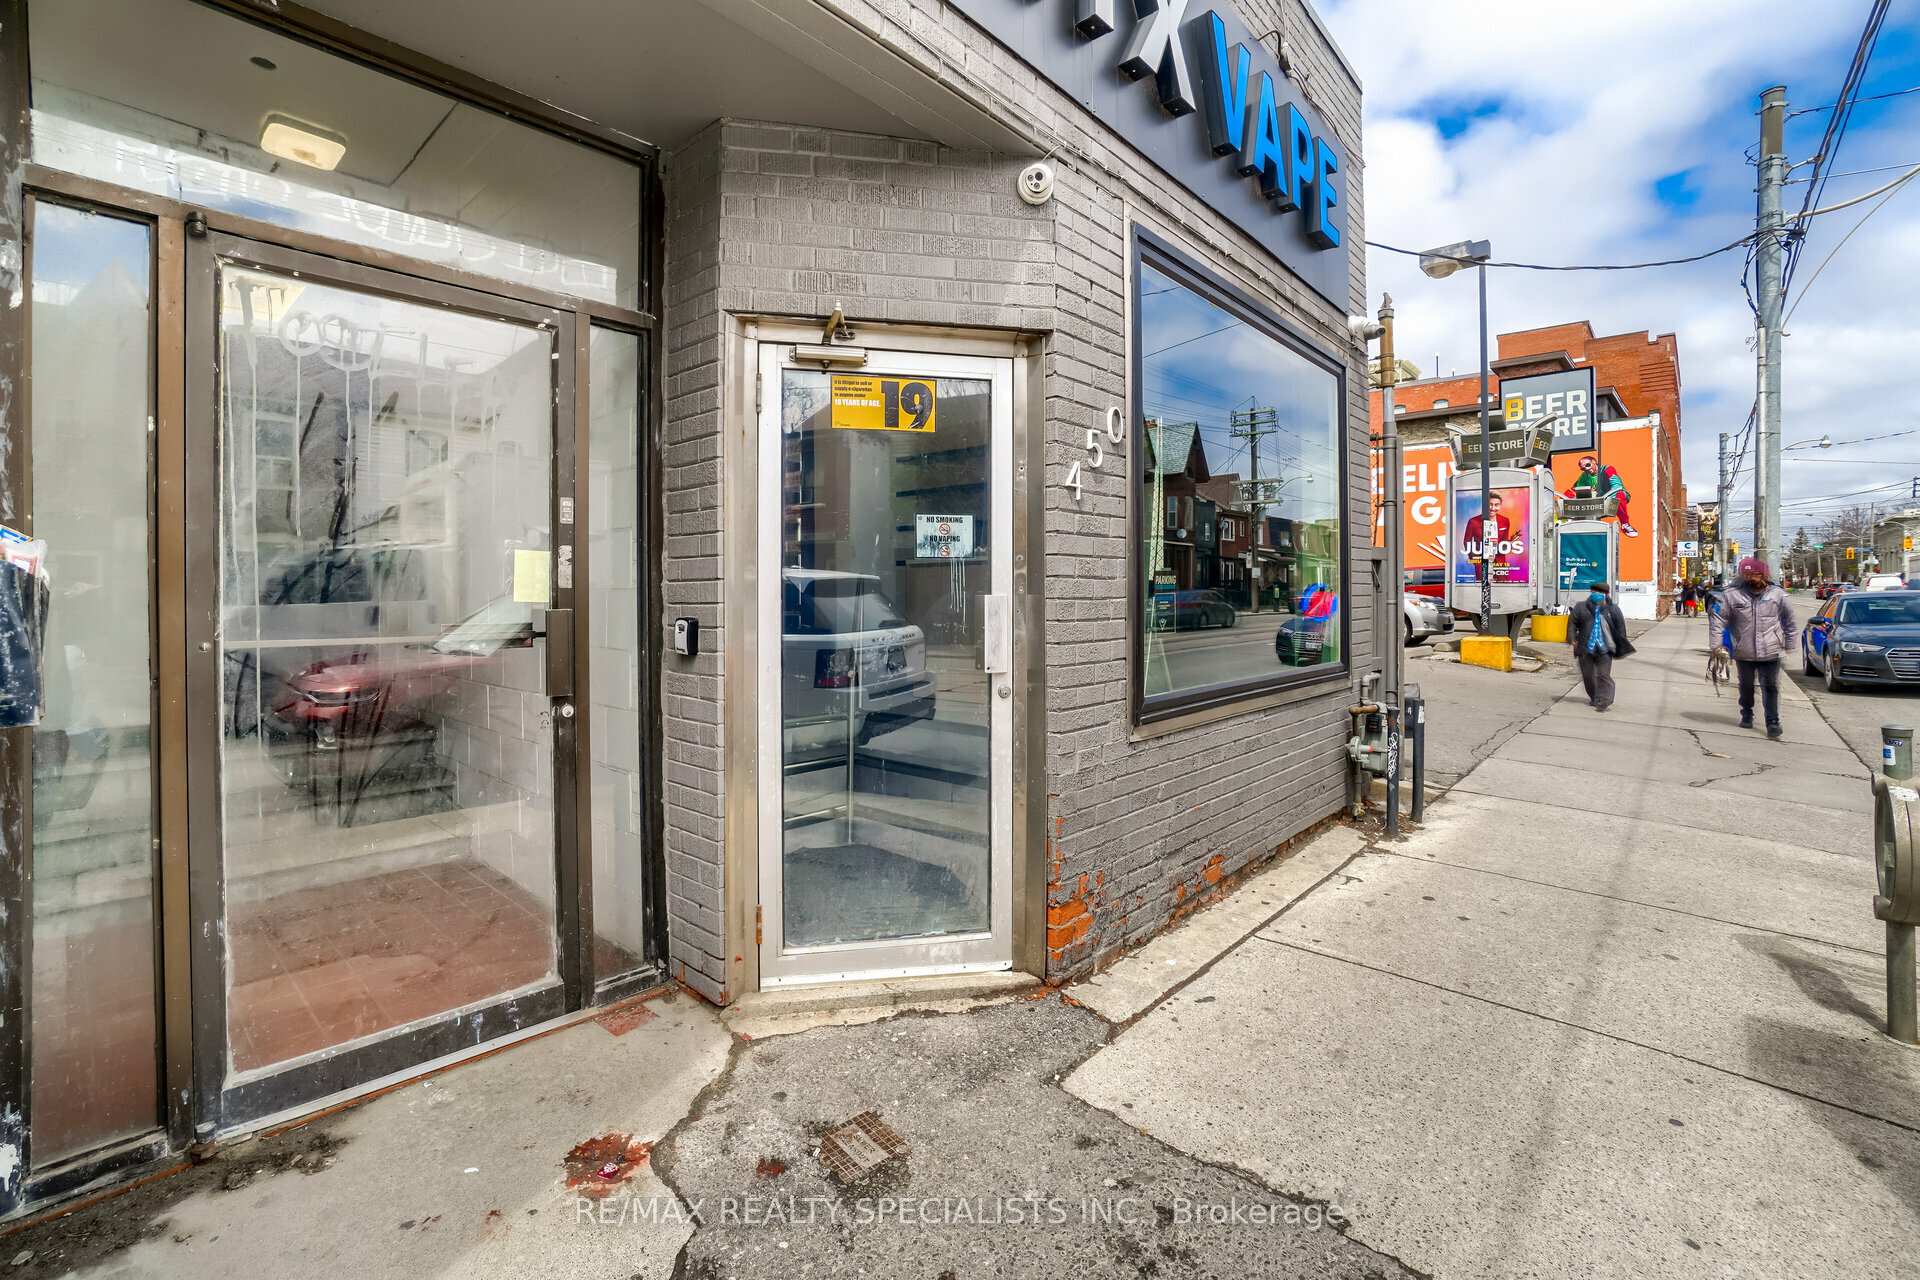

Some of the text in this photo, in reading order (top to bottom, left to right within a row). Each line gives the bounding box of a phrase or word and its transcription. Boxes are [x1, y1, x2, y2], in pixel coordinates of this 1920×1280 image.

[1195, 8, 1341, 249] VAPE
[868, 400, 881, 408] AGE
[880, 380, 934, 430] 19
[1504, 389, 1587, 422] BEER
[1488, 438, 1524, 452] STORE
[935, 516, 964, 524] SMOKING
[929, 535, 961, 543] NO VAPING
[1459, 540, 1524, 555] JUOS
